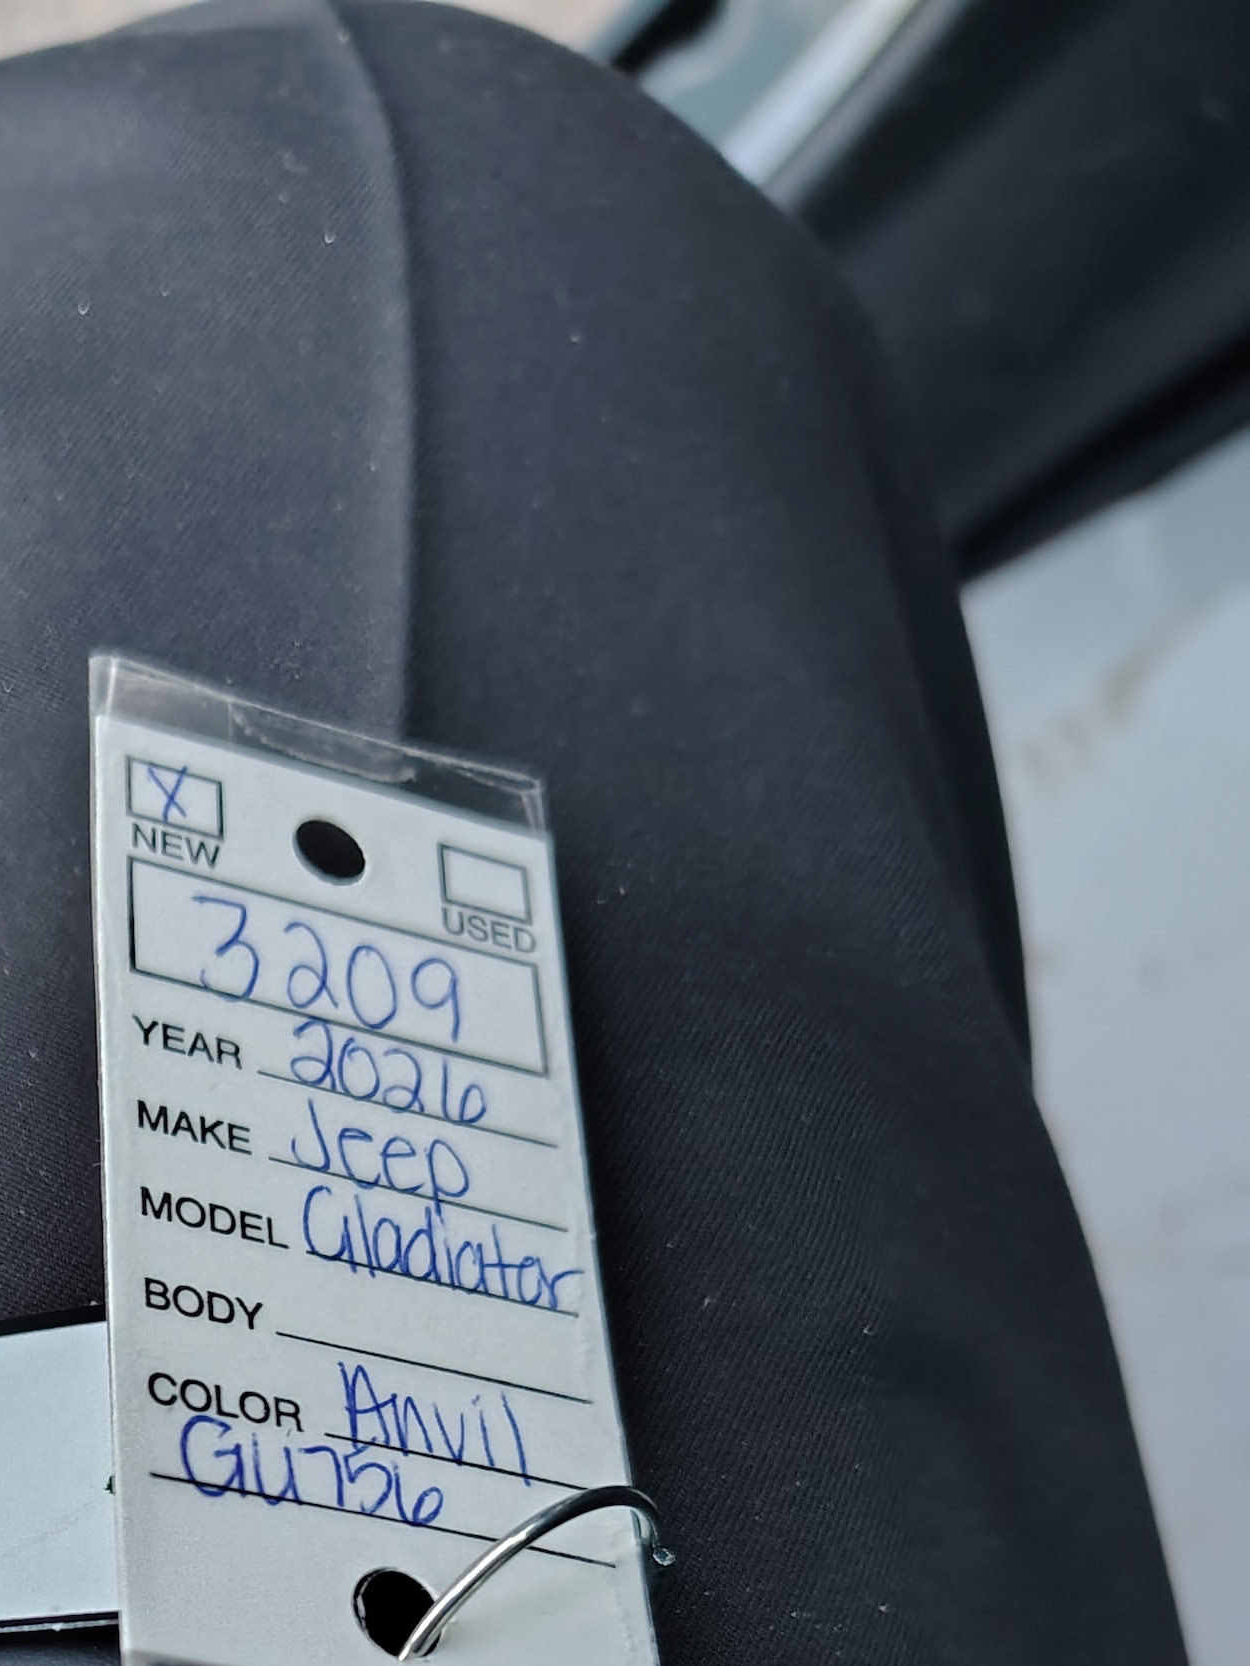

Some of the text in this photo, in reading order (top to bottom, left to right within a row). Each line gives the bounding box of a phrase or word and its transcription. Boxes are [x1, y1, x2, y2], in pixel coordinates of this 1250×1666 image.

[131, 823, 221, 869] NEW
[192, 896, 460, 1042] 3209
[441, 906, 536, 954] USED
[132, 1015, 487, 1125] YEAR 2026
[137, 1098, 470, 1215] MAKE Jeep
[139, 1185, 585, 1310] MODEL Gladiator
[144, 1277, 263, 1330] BODY
[147, 1361, 531, 1486] COLOR Anvil
